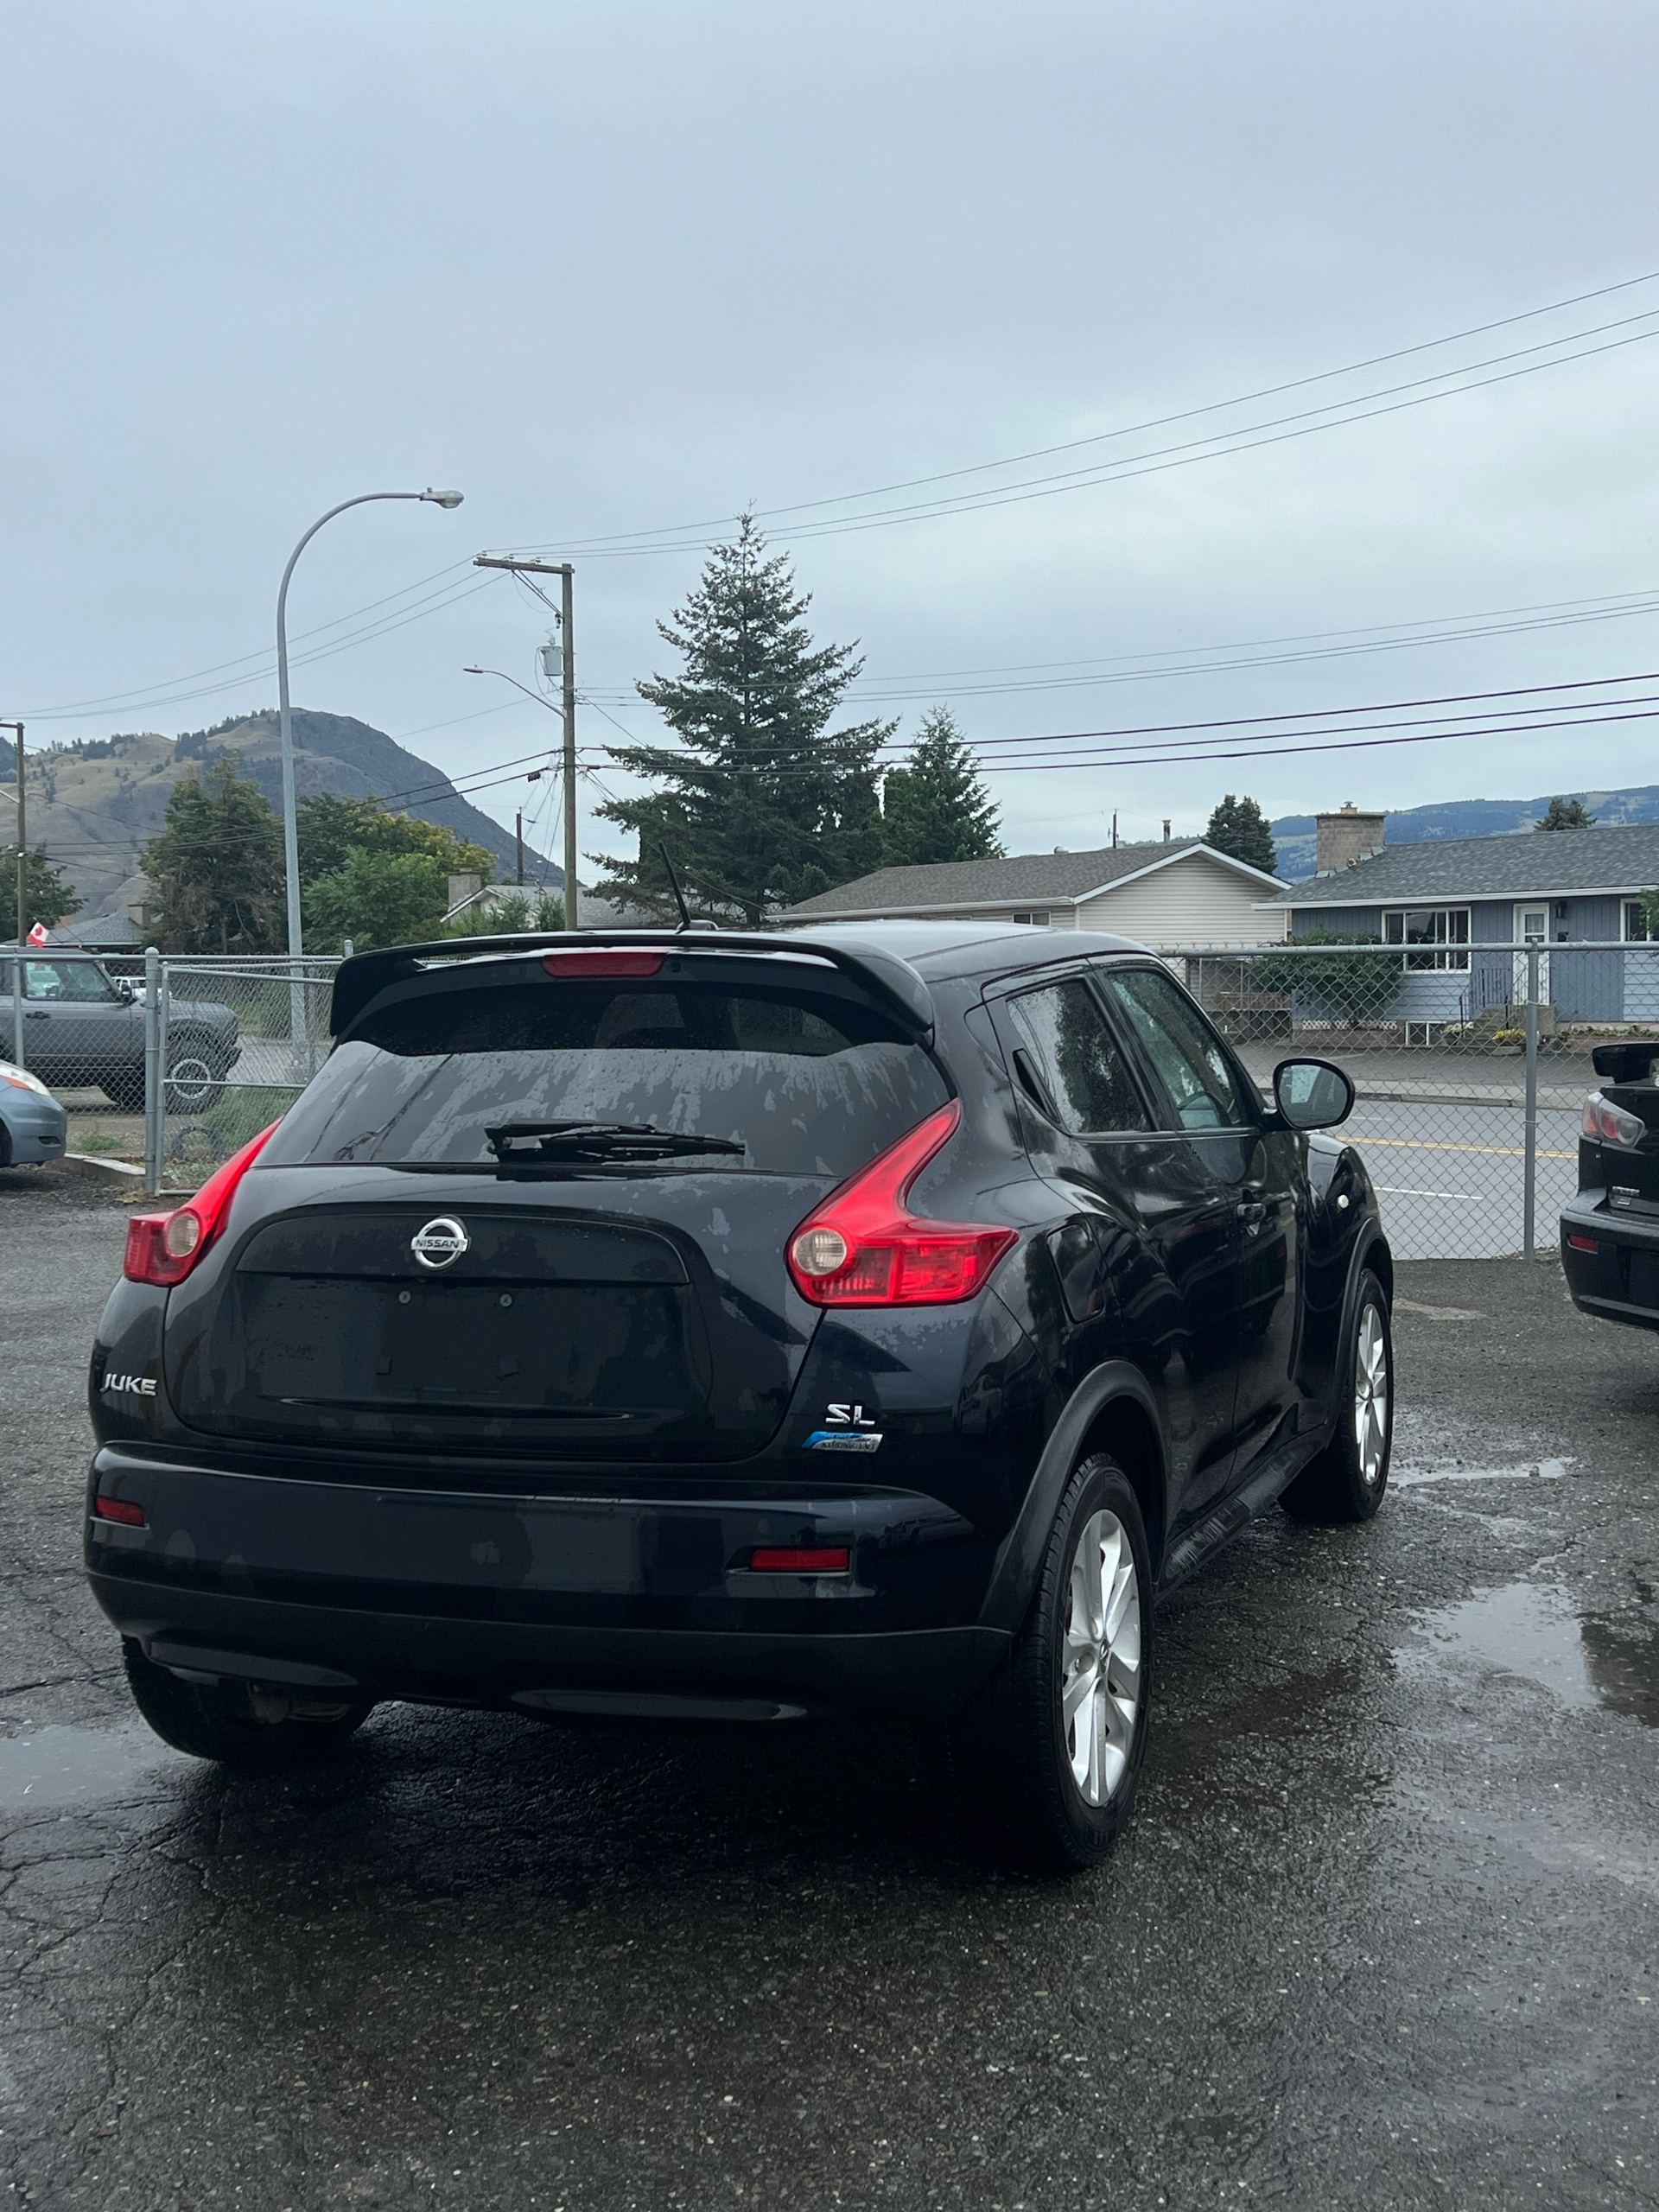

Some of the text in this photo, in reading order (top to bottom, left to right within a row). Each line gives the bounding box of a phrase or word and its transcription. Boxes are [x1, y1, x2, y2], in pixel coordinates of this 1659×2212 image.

[416, 1239, 460, 1249] NISSAN
[99, 1374, 157, 1396] JUKE
[825, 1404, 875, 1425] SL
